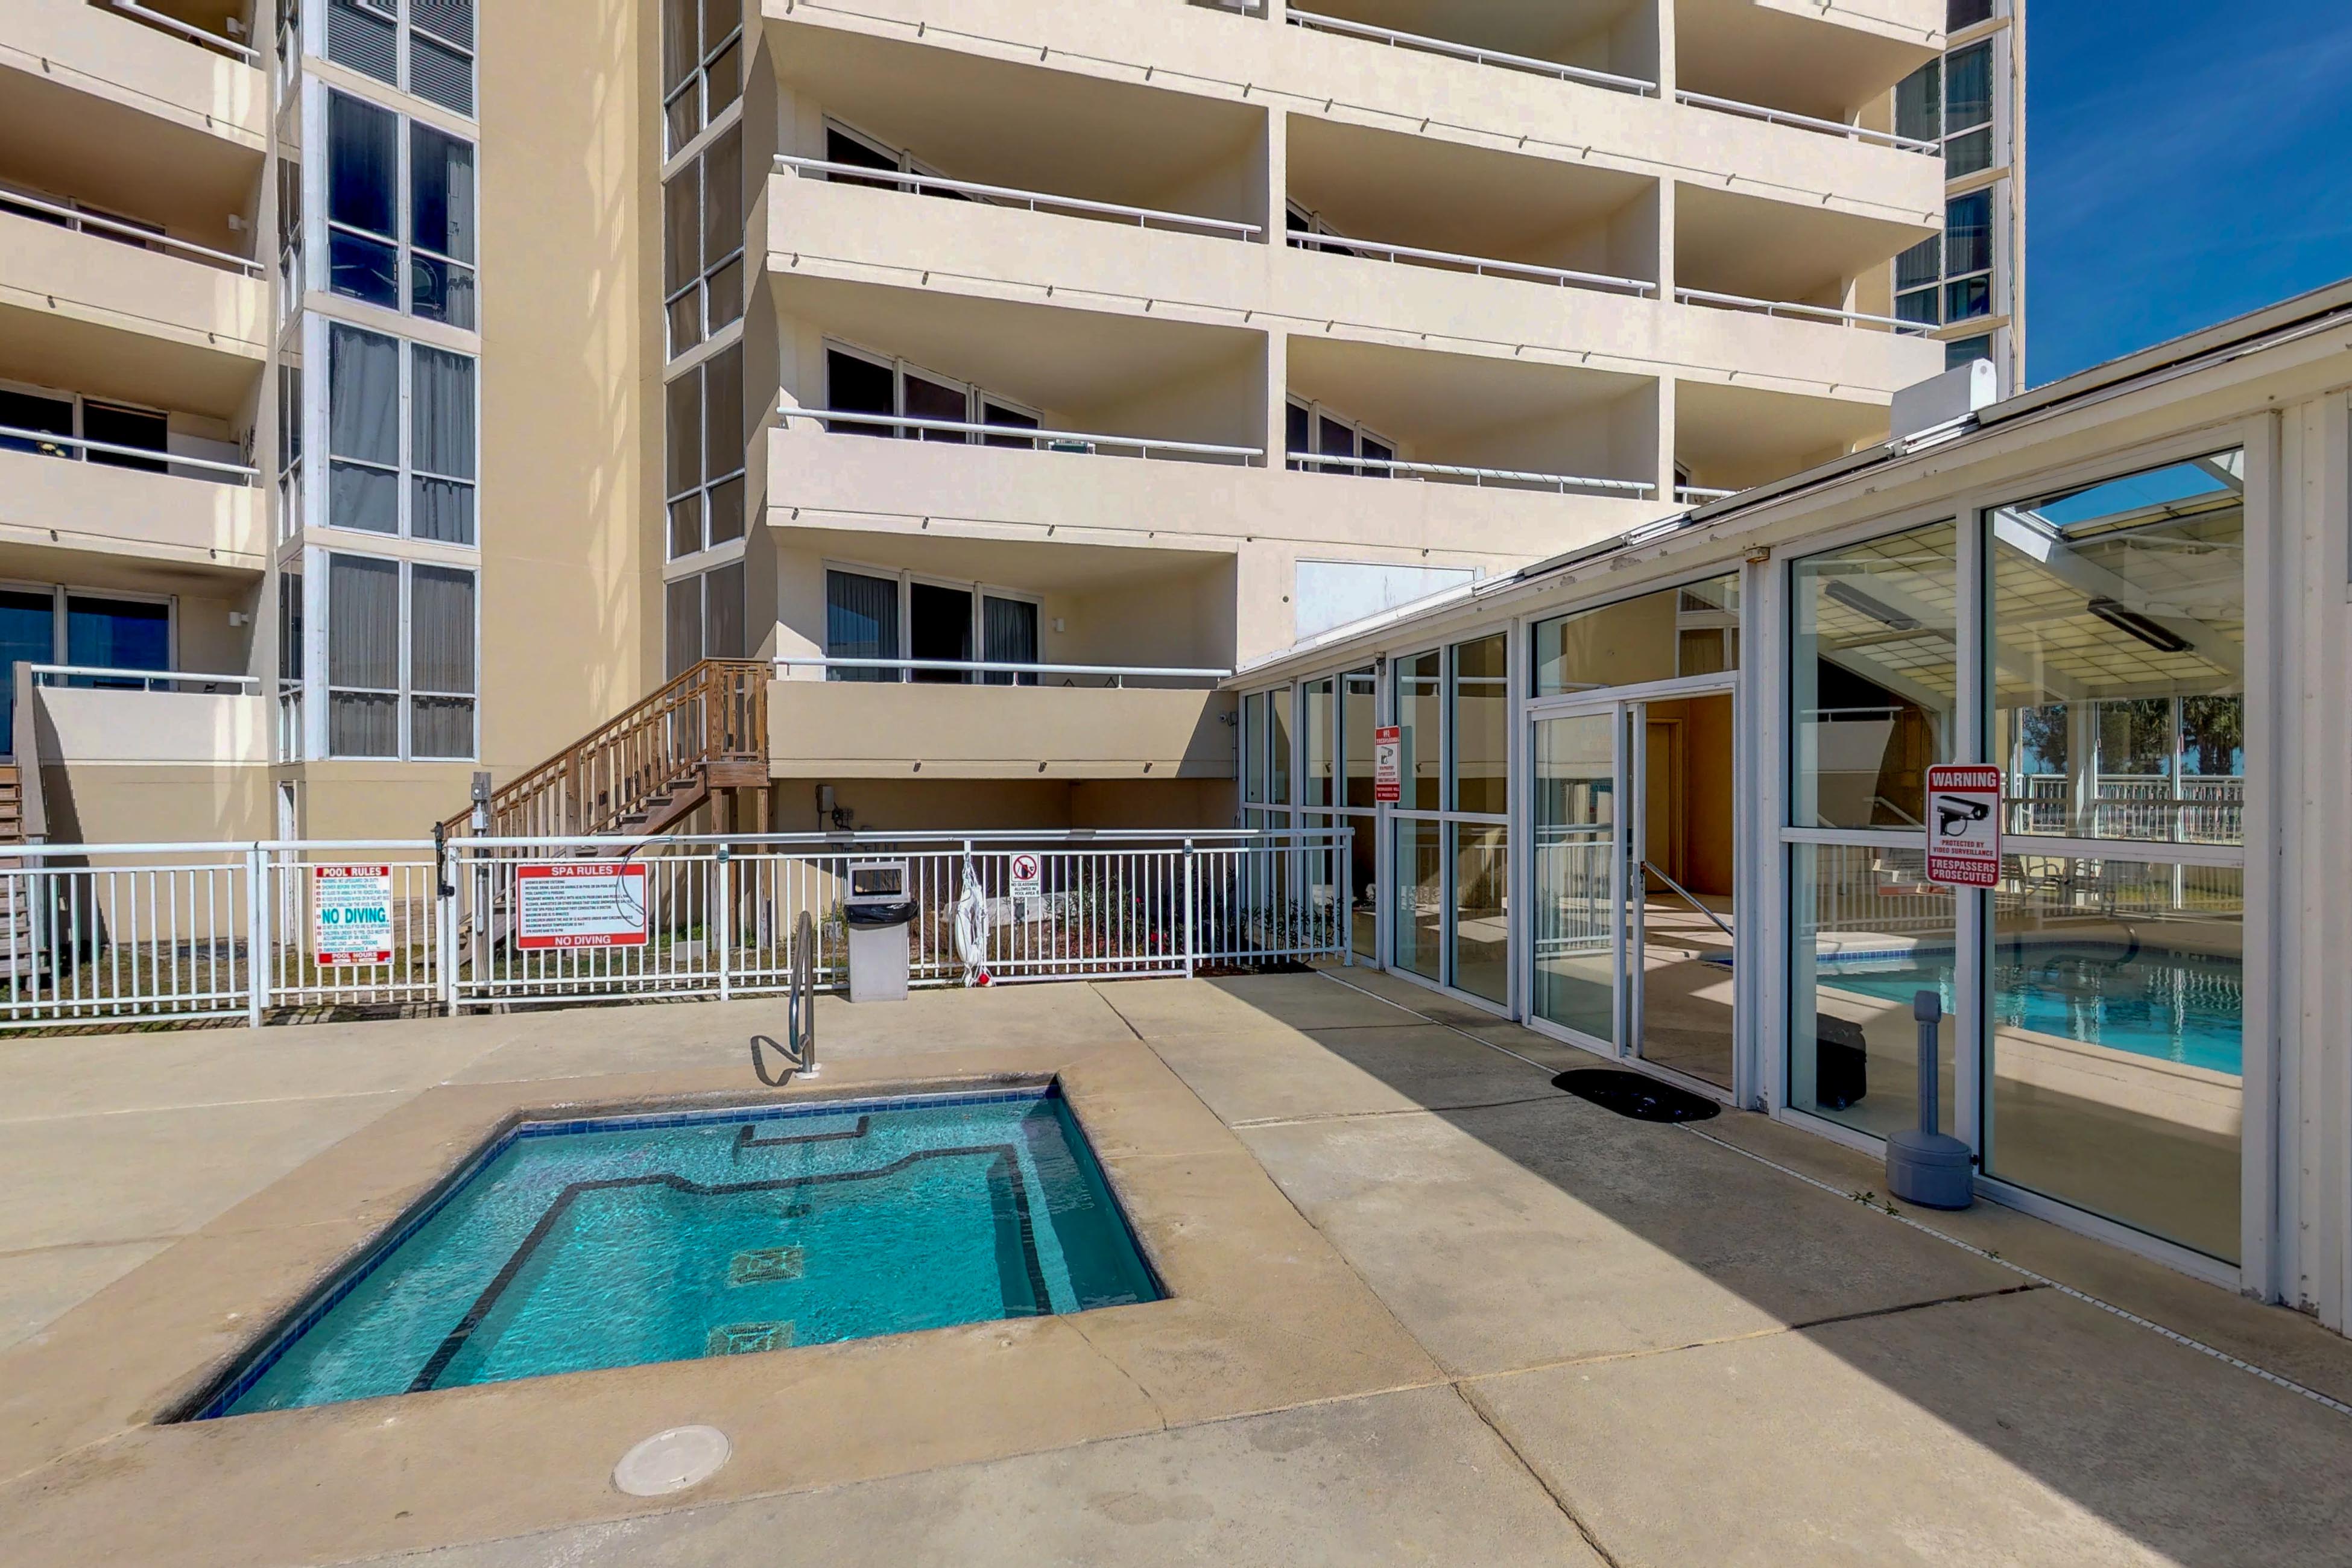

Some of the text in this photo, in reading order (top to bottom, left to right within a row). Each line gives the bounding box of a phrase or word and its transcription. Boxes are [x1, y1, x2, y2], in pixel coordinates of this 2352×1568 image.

[1932, 772, 1996, 788] WARNING
[1951, 848, 1993, 857] SURVEILLANCE
[323, 867, 382, 876] POOL RULES
[551, 866, 613, 876] SPA RULES
[1931, 859, 1996, 873] TRESPASSERS
[1933, 868, 1994, 883] PROSECUTED
[322, 907, 390, 924] NO DIVING.
[555, 935, 611, 946] NO DIVING
